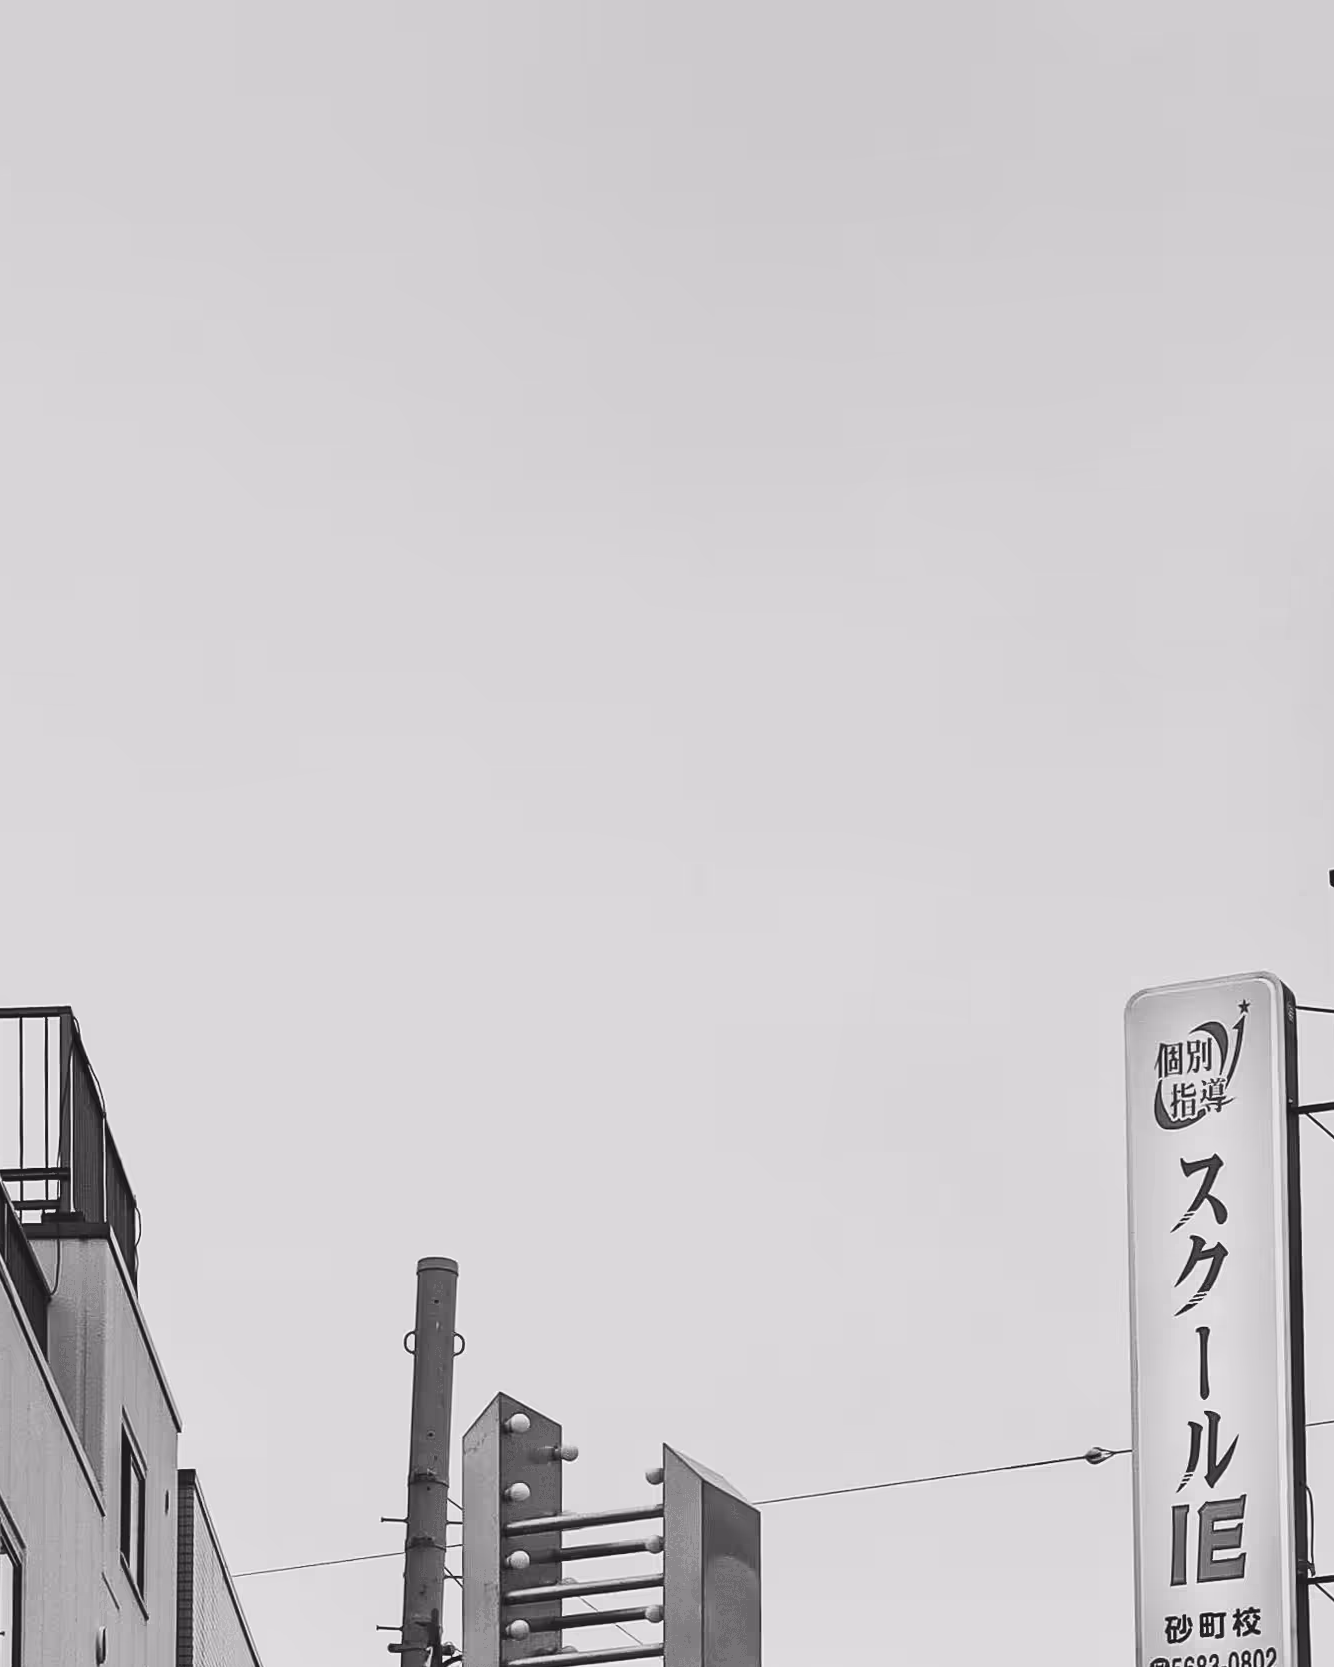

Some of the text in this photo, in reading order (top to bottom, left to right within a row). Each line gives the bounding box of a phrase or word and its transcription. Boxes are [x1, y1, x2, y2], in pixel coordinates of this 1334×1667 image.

[1154, 1037, 1213, 1079] 個別
[1170, 1077, 1229, 1119] 指導
[1164, 1606, 1262, 1644] 砂町校
